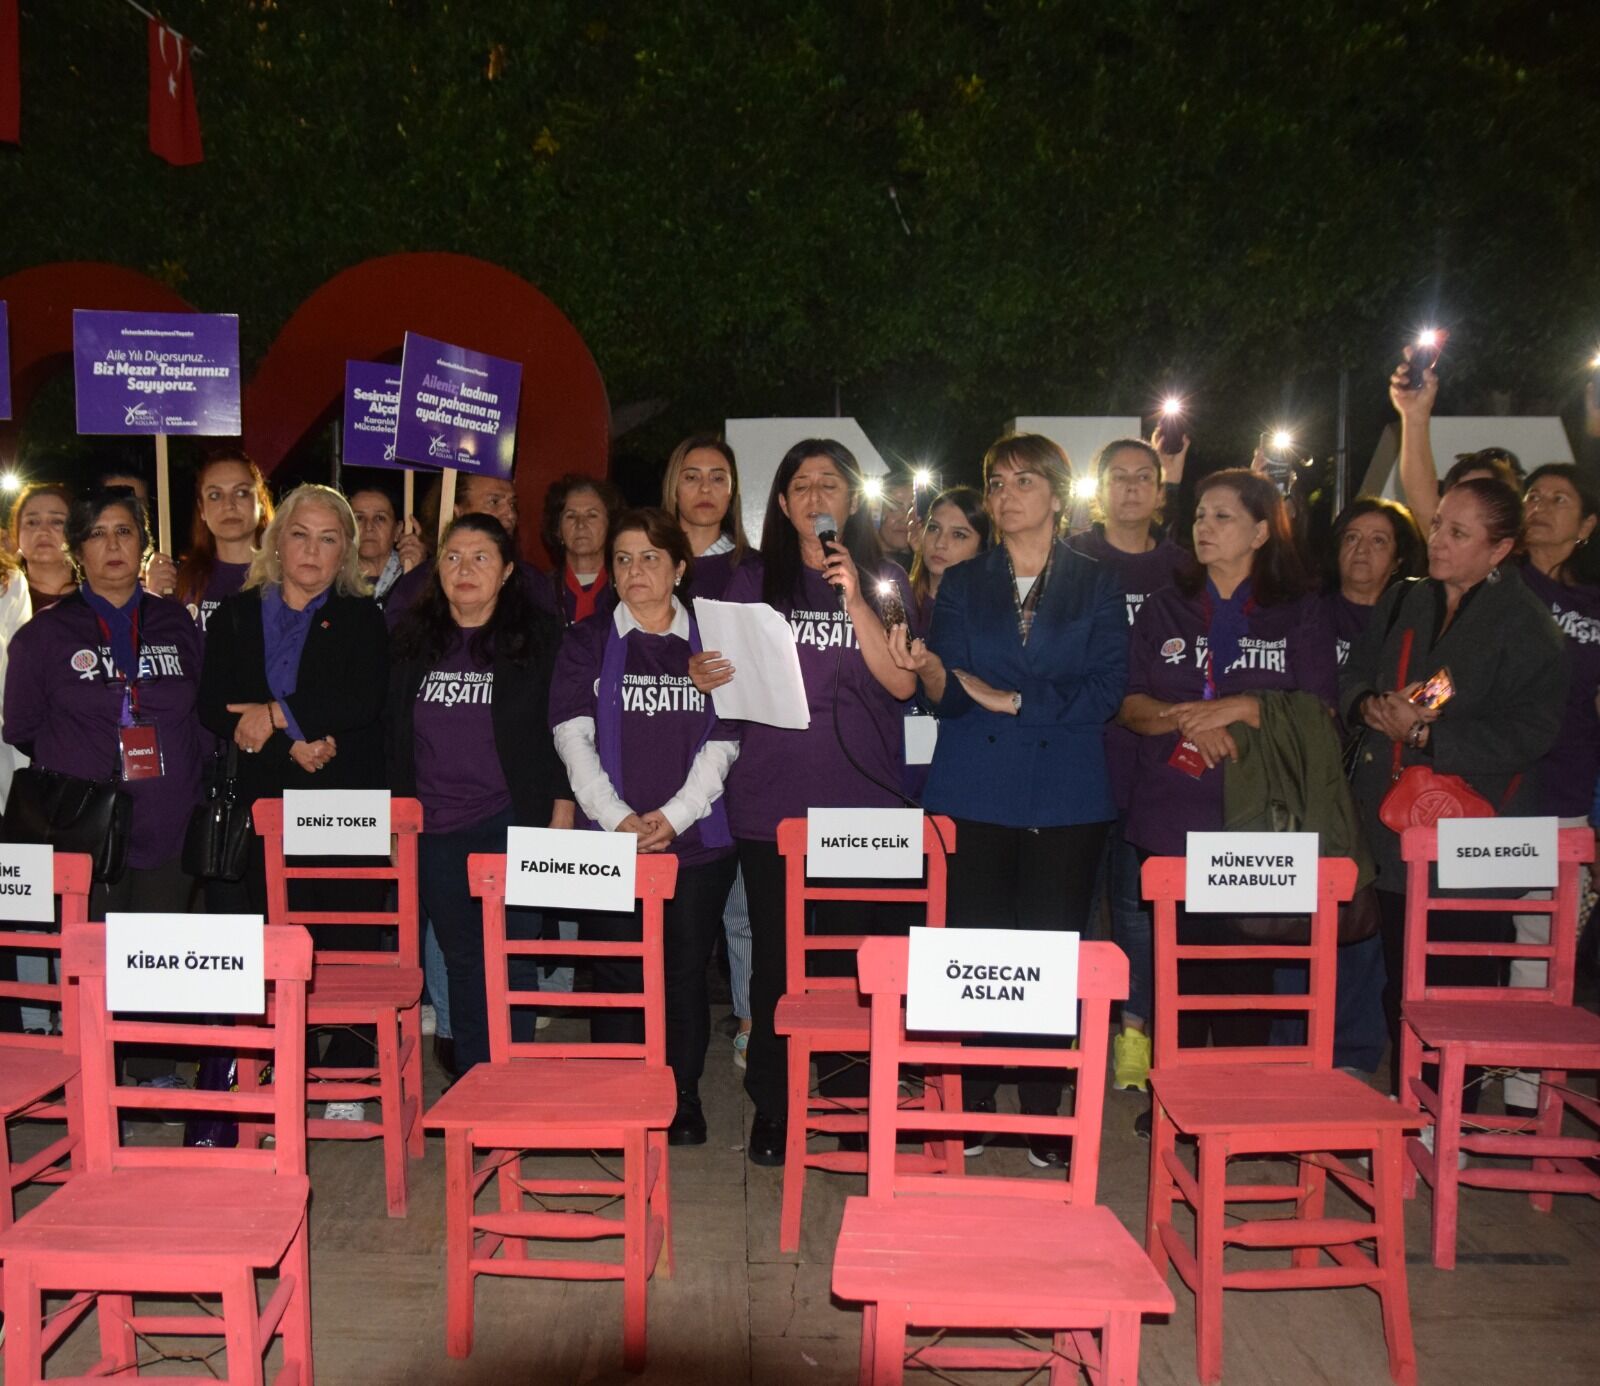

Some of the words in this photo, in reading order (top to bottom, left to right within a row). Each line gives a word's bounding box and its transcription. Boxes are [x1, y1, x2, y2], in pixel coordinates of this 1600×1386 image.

[106, 349, 126, 362] Aile
[129, 350, 143, 362] Yılı
[93, 361, 114, 375] Biz
[116, 363, 157, 376] Mezar
[160, 363, 229, 378] Taşlarımızı
[127, 378, 197, 393] Sayıyoruz.
[422, 373, 460, 396] Aileniz;
[460, 382, 498, 404] kadının
[416, 391, 439, 406] canı
[439, 396, 487, 417] pahasına
[487, 408, 501, 420] mı
[364, 415, 396, 426] Karanlık
[415, 407, 452, 424] ayakta
[452, 412, 500, 435] duracak?
[791, 609, 831, 620] İSTANBUL
[791, 620, 860, 651] YAŞAT
[429, 671, 463, 681] İSTANBUL
[623, 674, 658, 685] STANBUL
[296, 814, 333, 827] DENİZ
[337, 816, 377, 827] TOKER
[821, 835, 868, 849] HATİCE
[871, 835, 909, 850] ÇELİK
[1456, 847, 1491, 858] SEDA
[1494, 844, 1539, 858] ERGÜL
[1211, 851, 1294, 868] MÜNEVVER
[520, 858, 576, 875] FADİME
[579, 863, 621, 877] KOCA
[1208, 874, 1297, 887] KARABULUT
[127, 950, 179, 969] KİBAR
[184, 951, 244, 970] ÖZTEN
[946, 961, 1041, 982] ÖZGECAN
[961, 985, 1025, 1001] ASLAN
